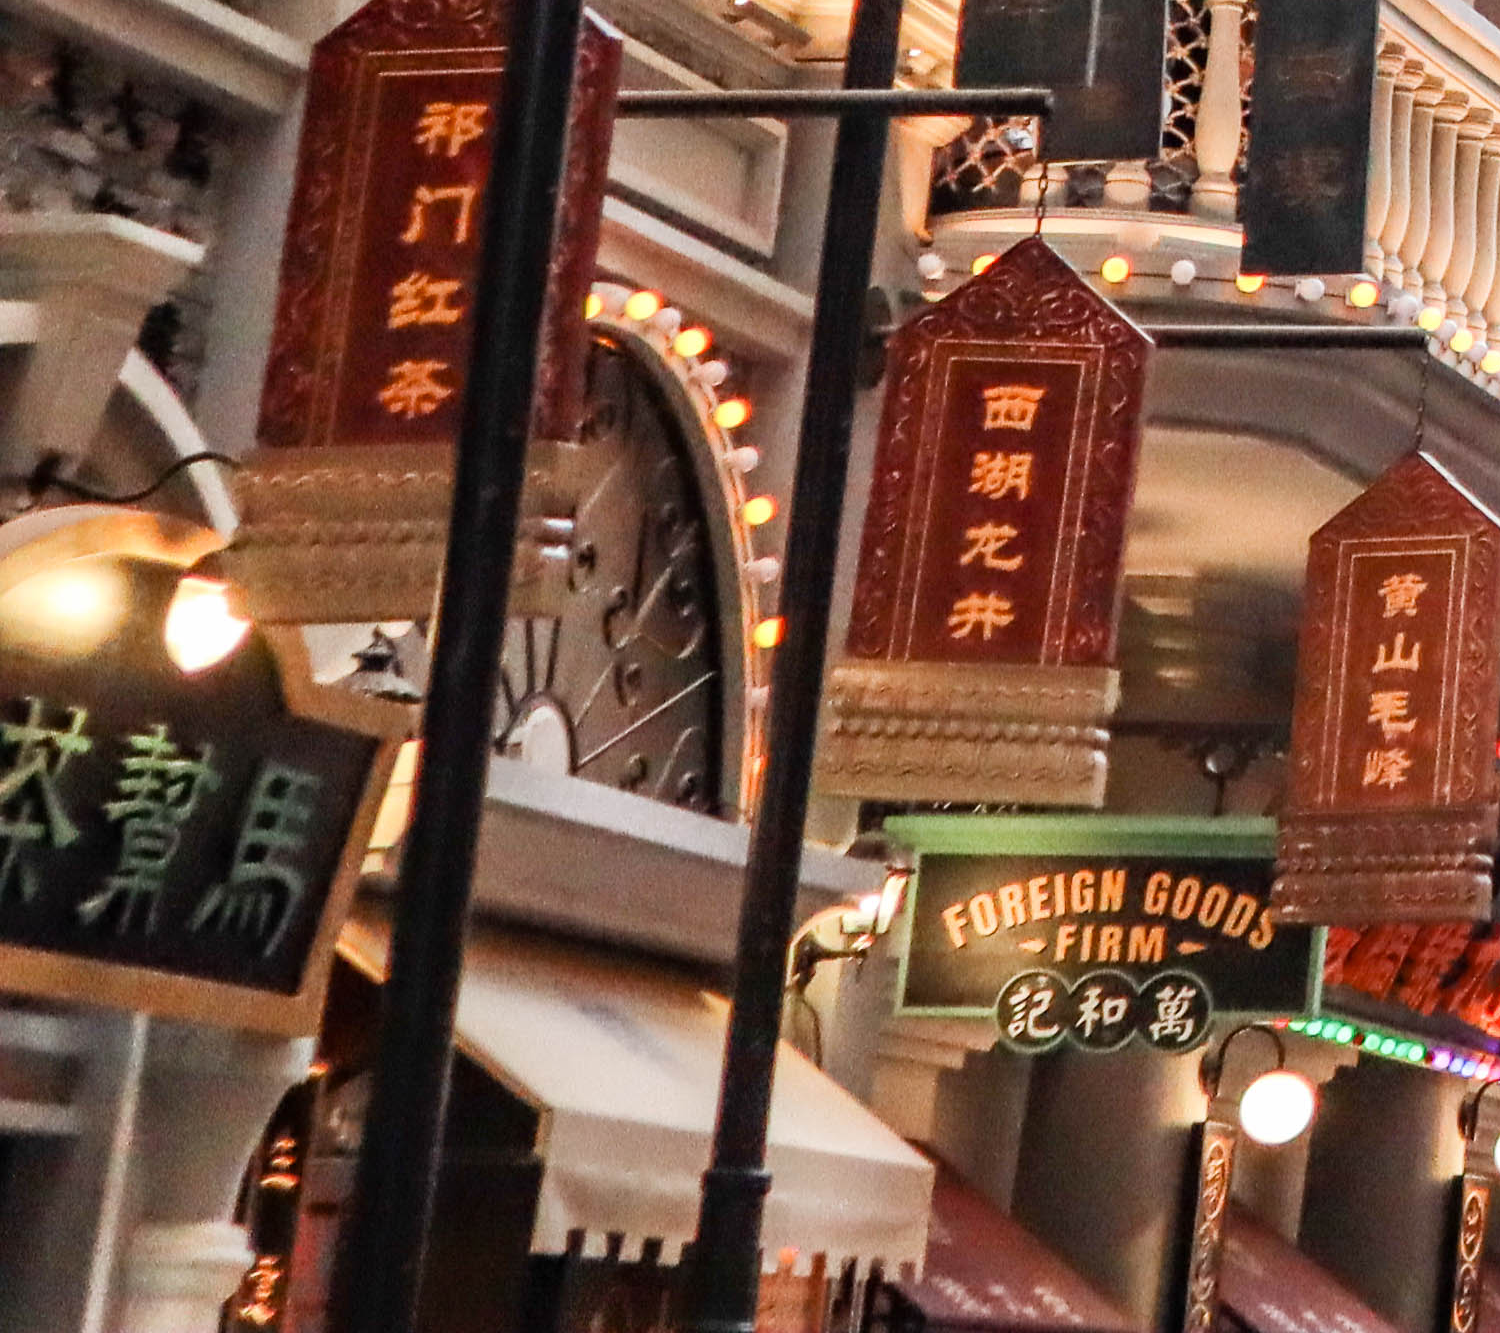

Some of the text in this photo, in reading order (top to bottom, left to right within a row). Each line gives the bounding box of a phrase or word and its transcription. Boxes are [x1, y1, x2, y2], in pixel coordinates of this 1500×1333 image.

[378, 101, 488, 421] 祁门红茶
[948, 384, 1046, 641] 西湖龙井
[1361, 573, 1427, 791] 黄山毛峰
[941, 868, 1275, 951] FOREIGN GOODS
[1054, 924, 1167, 964] FIRM
[1007, 982, 1196, 1044] 萬和記
